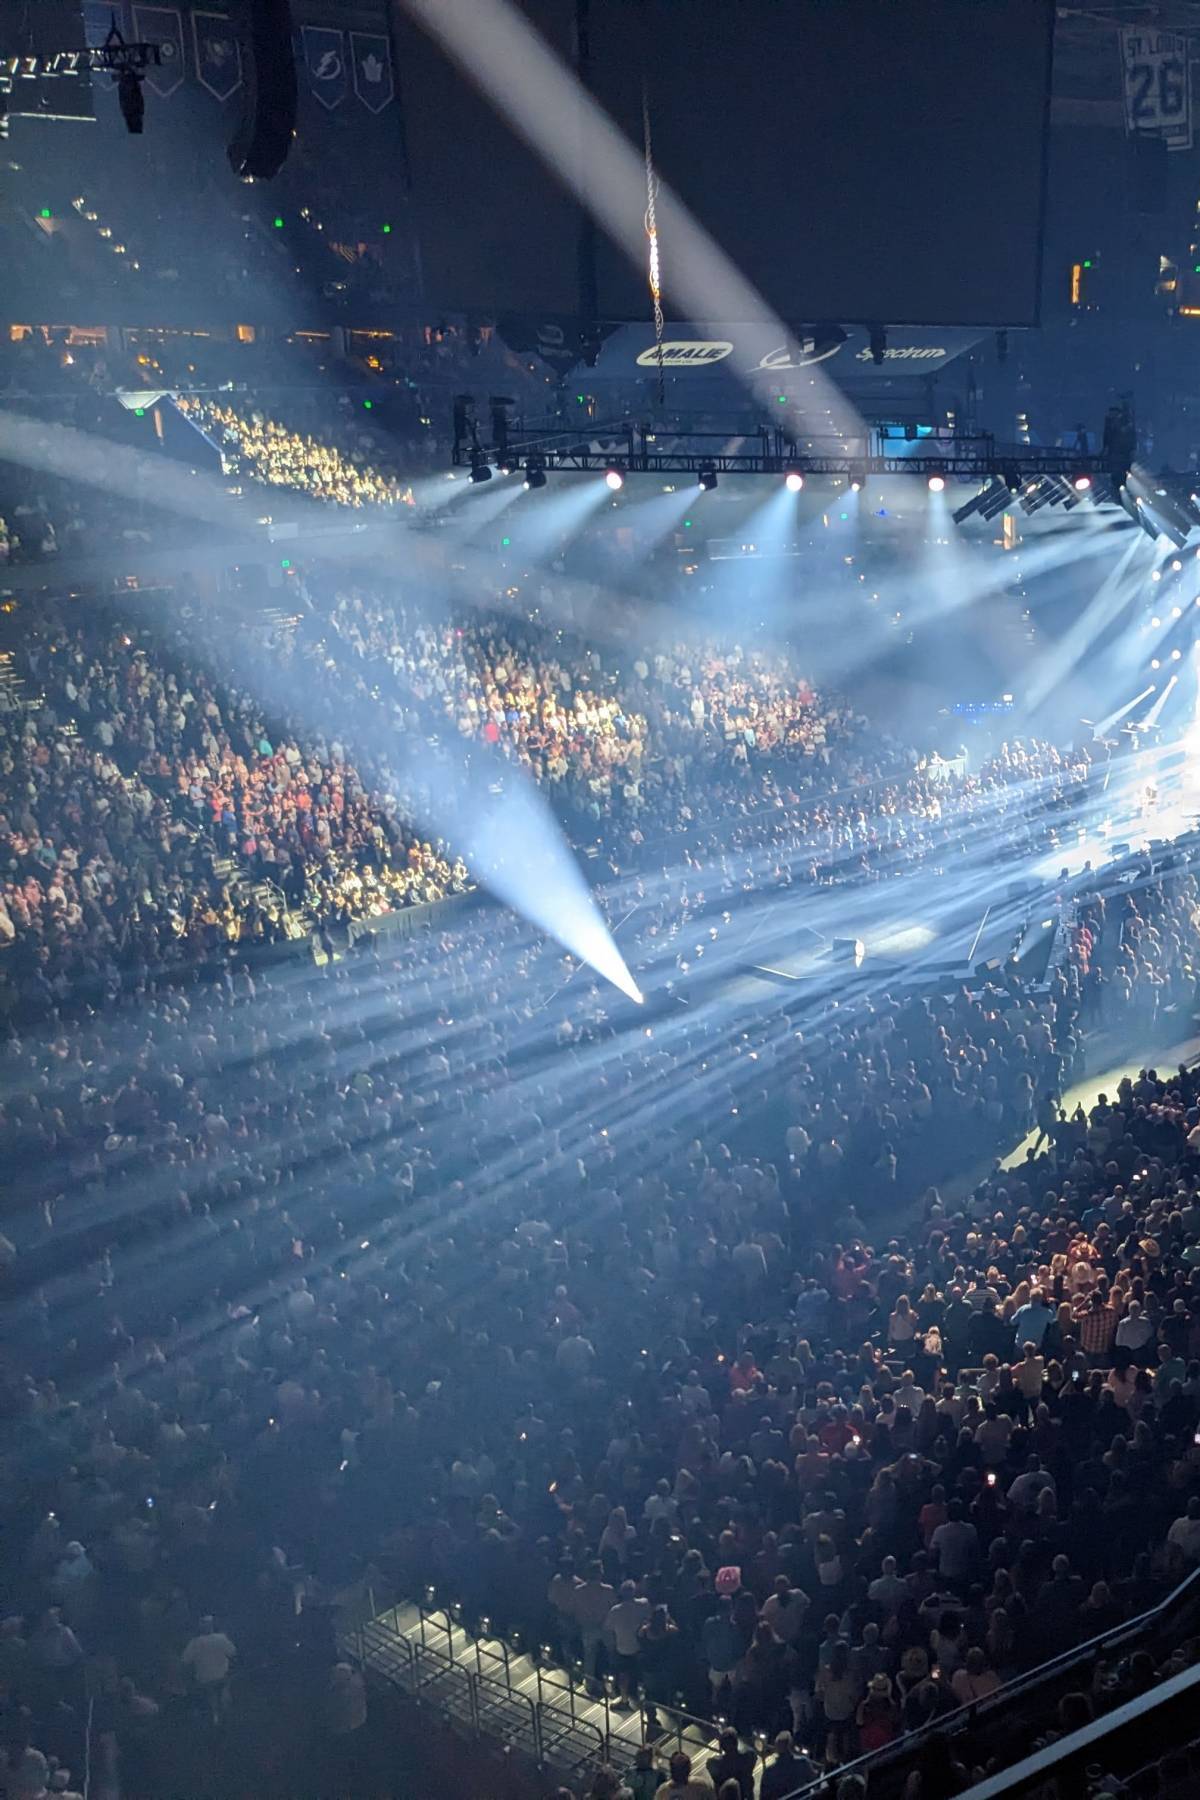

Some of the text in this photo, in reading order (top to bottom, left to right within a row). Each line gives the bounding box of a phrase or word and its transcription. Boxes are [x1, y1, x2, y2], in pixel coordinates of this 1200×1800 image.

[1129, 61, 1184, 118] 26
[643, 347, 728, 360] AMALIE
[855, 346, 947, 361] Sectrum
